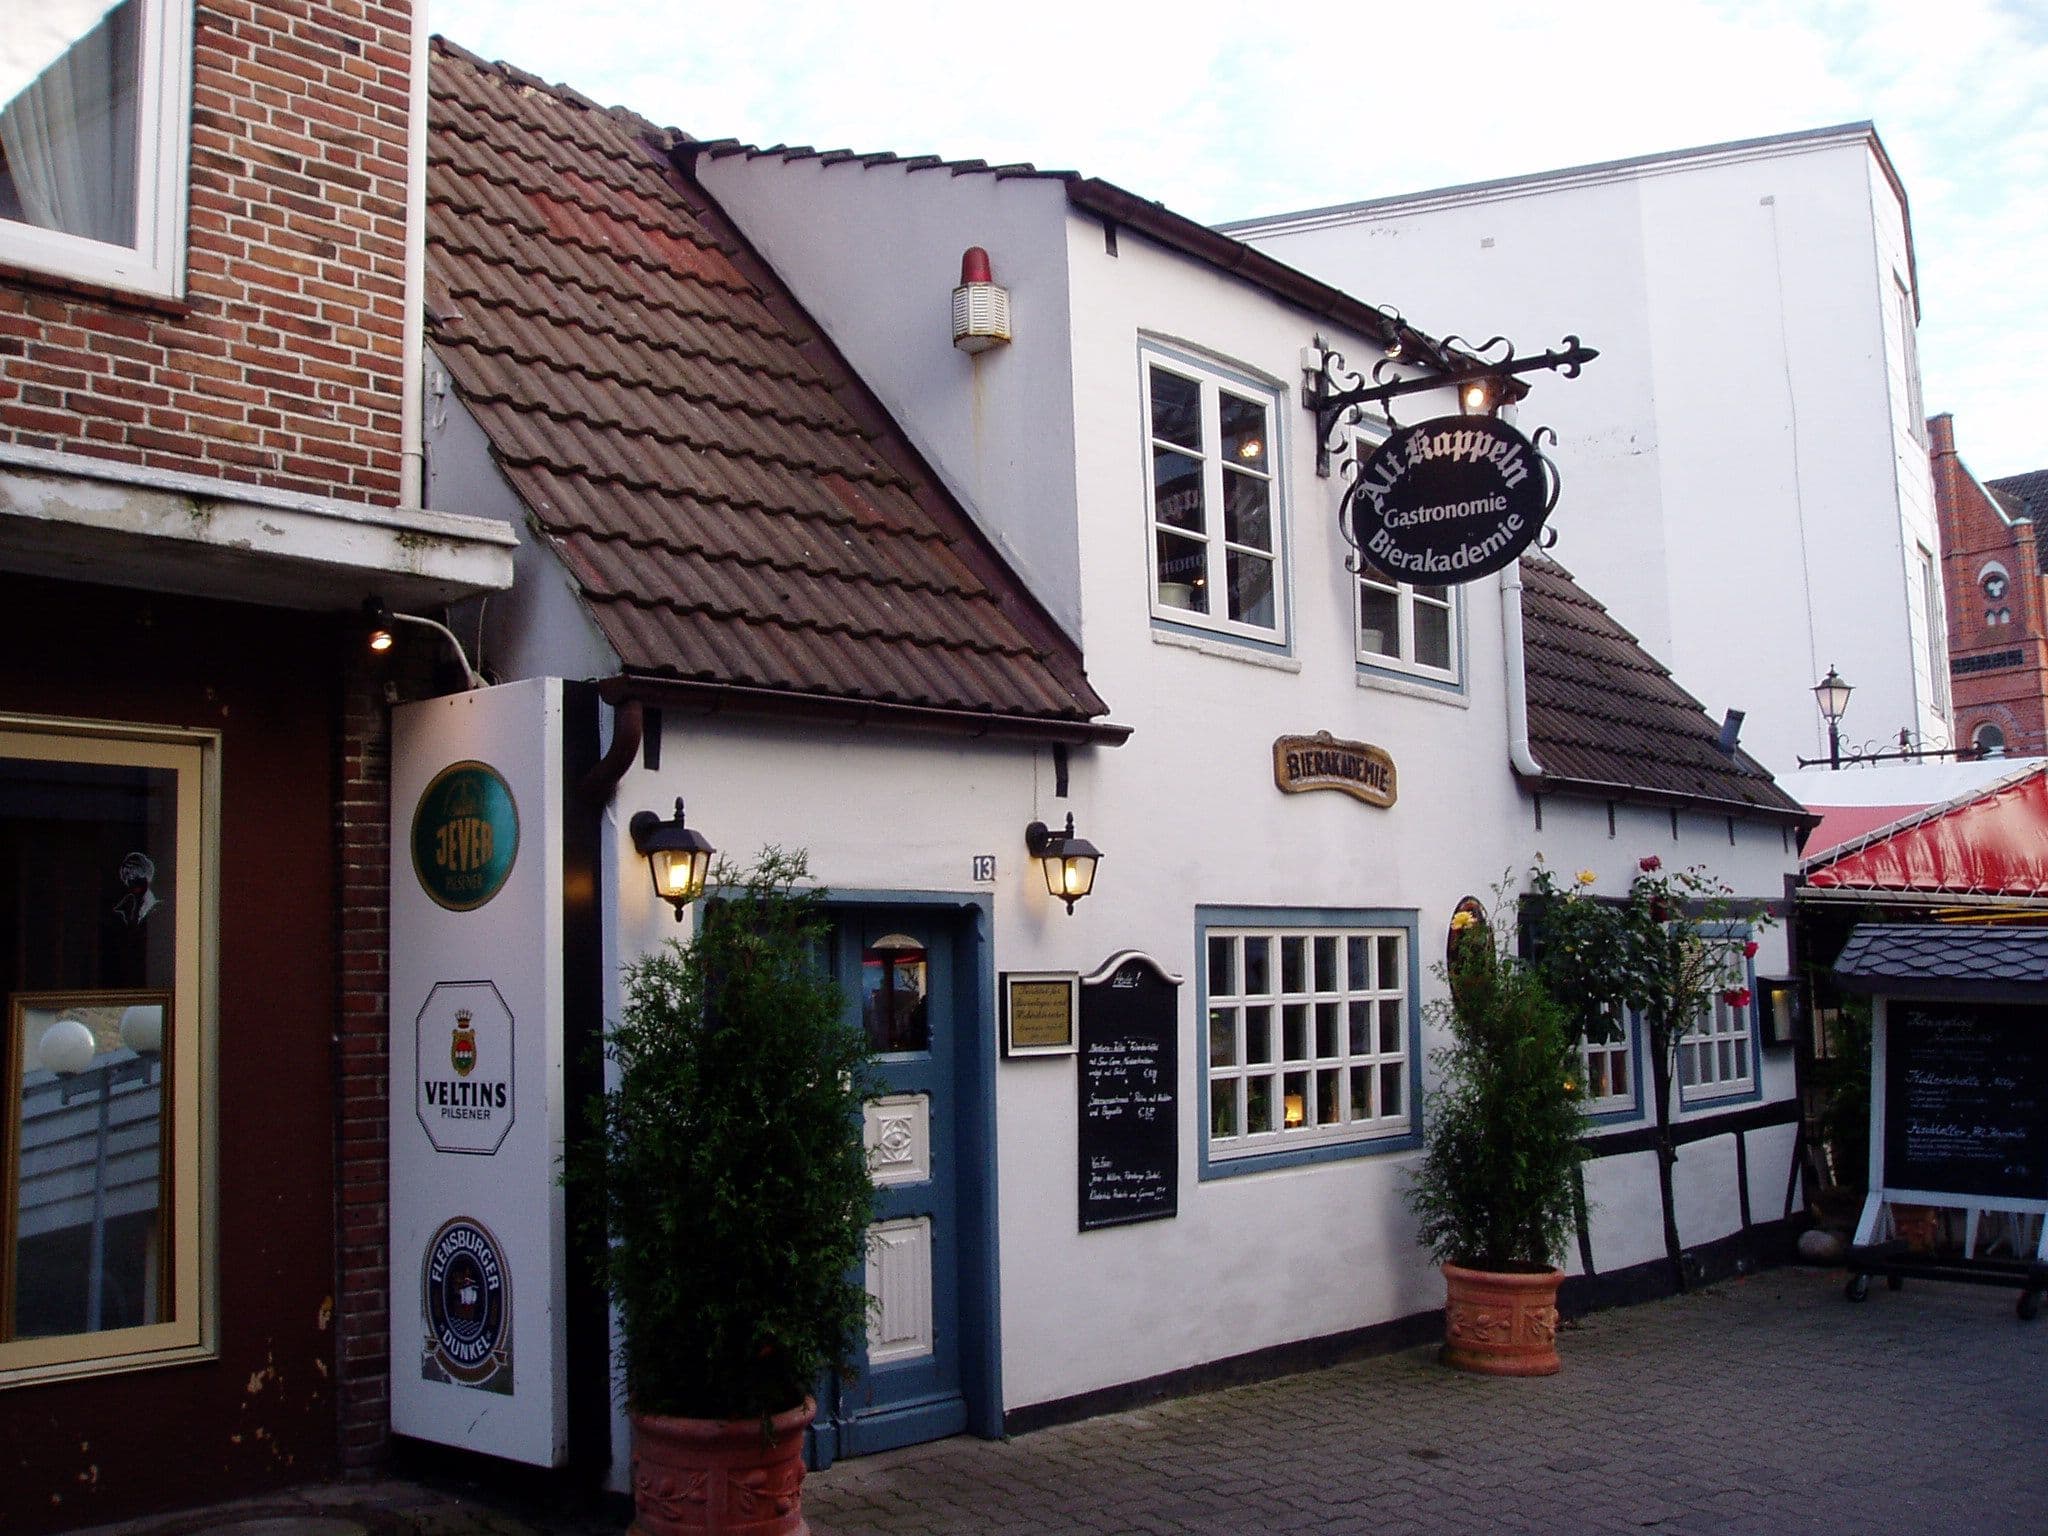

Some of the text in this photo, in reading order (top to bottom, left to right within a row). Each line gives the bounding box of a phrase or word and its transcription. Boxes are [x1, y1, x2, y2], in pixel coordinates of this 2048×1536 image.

[1356, 427, 1529, 515] Alt Kappeln
[1384, 492, 1507, 528] Gastronomie
[1368, 512, 1525, 572] Bierakademie
[436, 817, 494, 872] JEVER
[974, 857, 992, 880] 13
[424, 1081, 507, 1108] VELTINS
[441, 1107, 491, 1120] PILSENER
[432, 1229, 500, 1291] FLENSBURGER
[442, 1329, 491, 1362] DUNKEL
